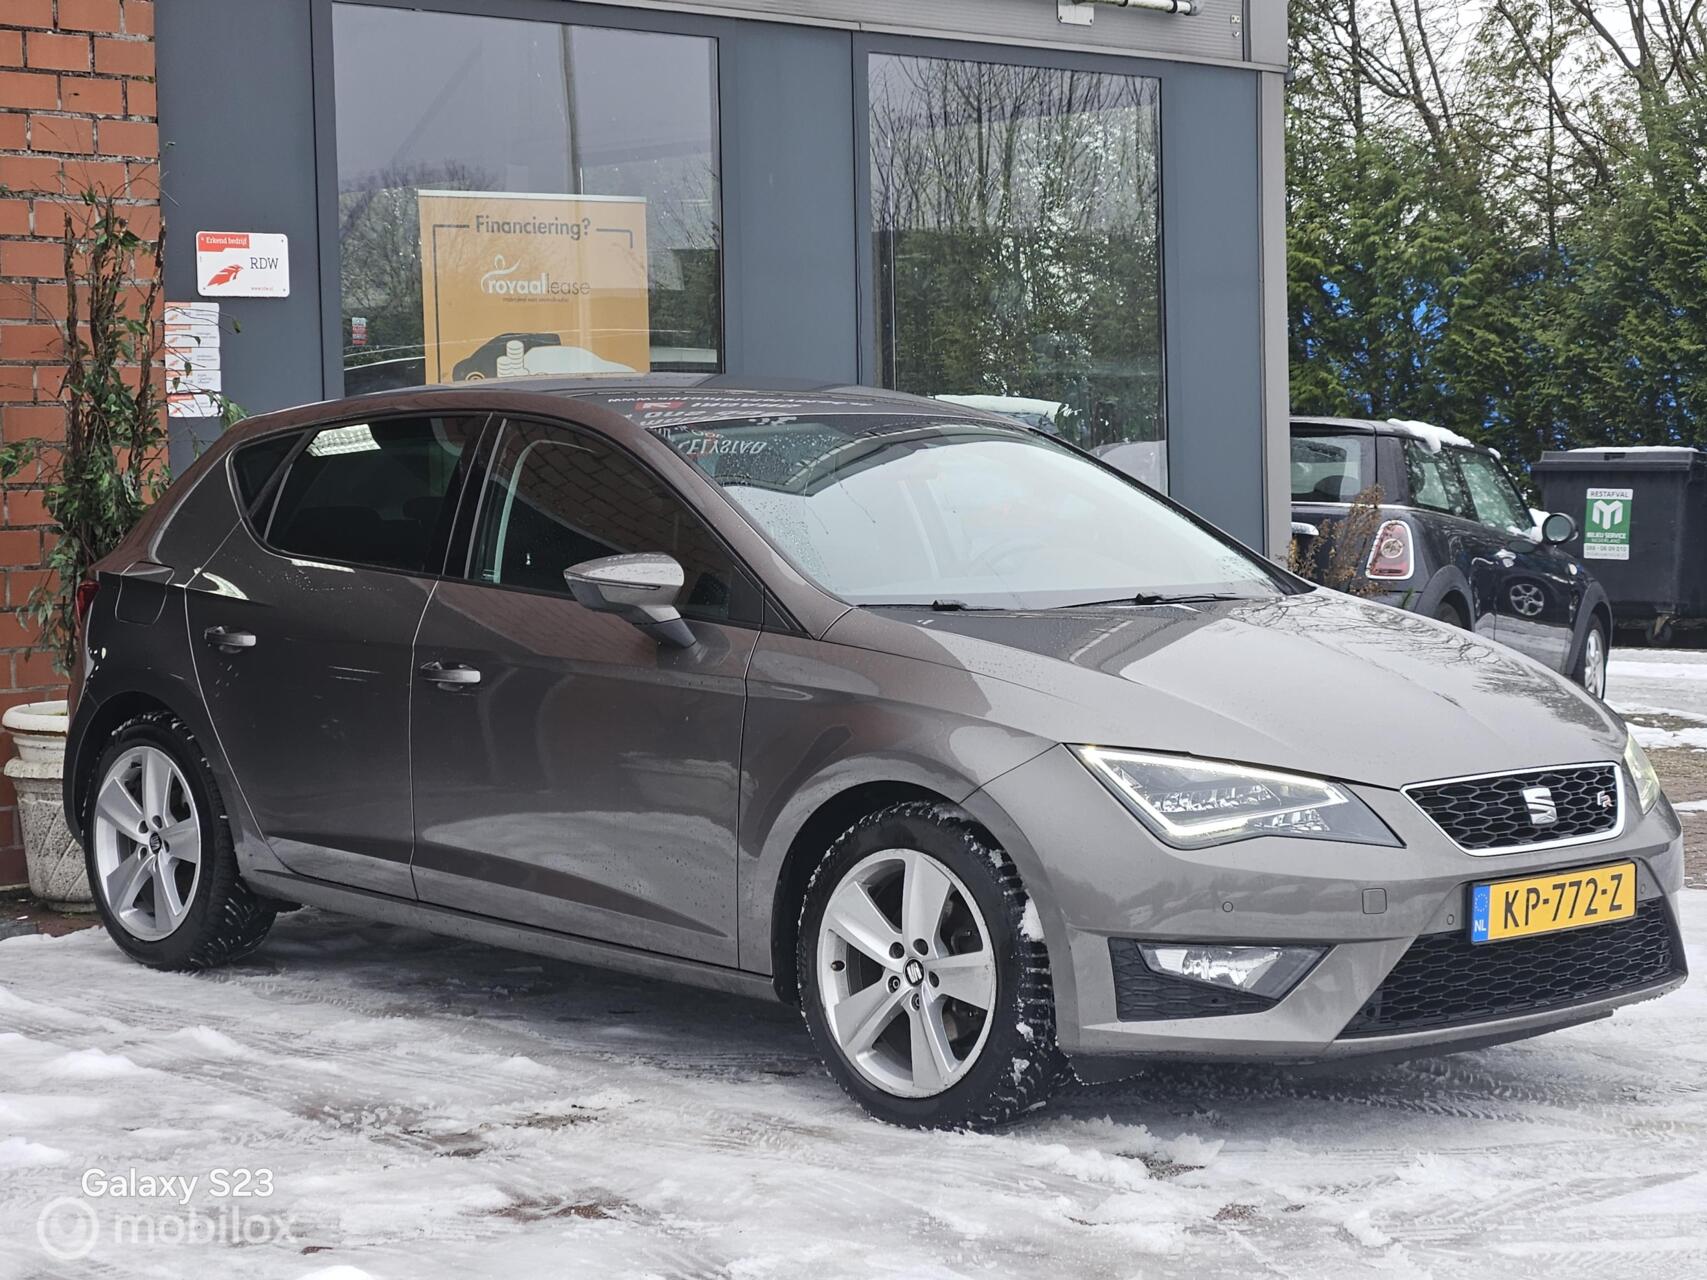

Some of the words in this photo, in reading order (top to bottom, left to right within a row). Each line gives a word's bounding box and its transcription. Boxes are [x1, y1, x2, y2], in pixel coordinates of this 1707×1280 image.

[475, 214, 592, 240] Financiering?
[250, 256, 279, 270] RDW
[1503, 873, 1623, 930] KP-772-Z
[1474, 919, 1487, 932] NL
